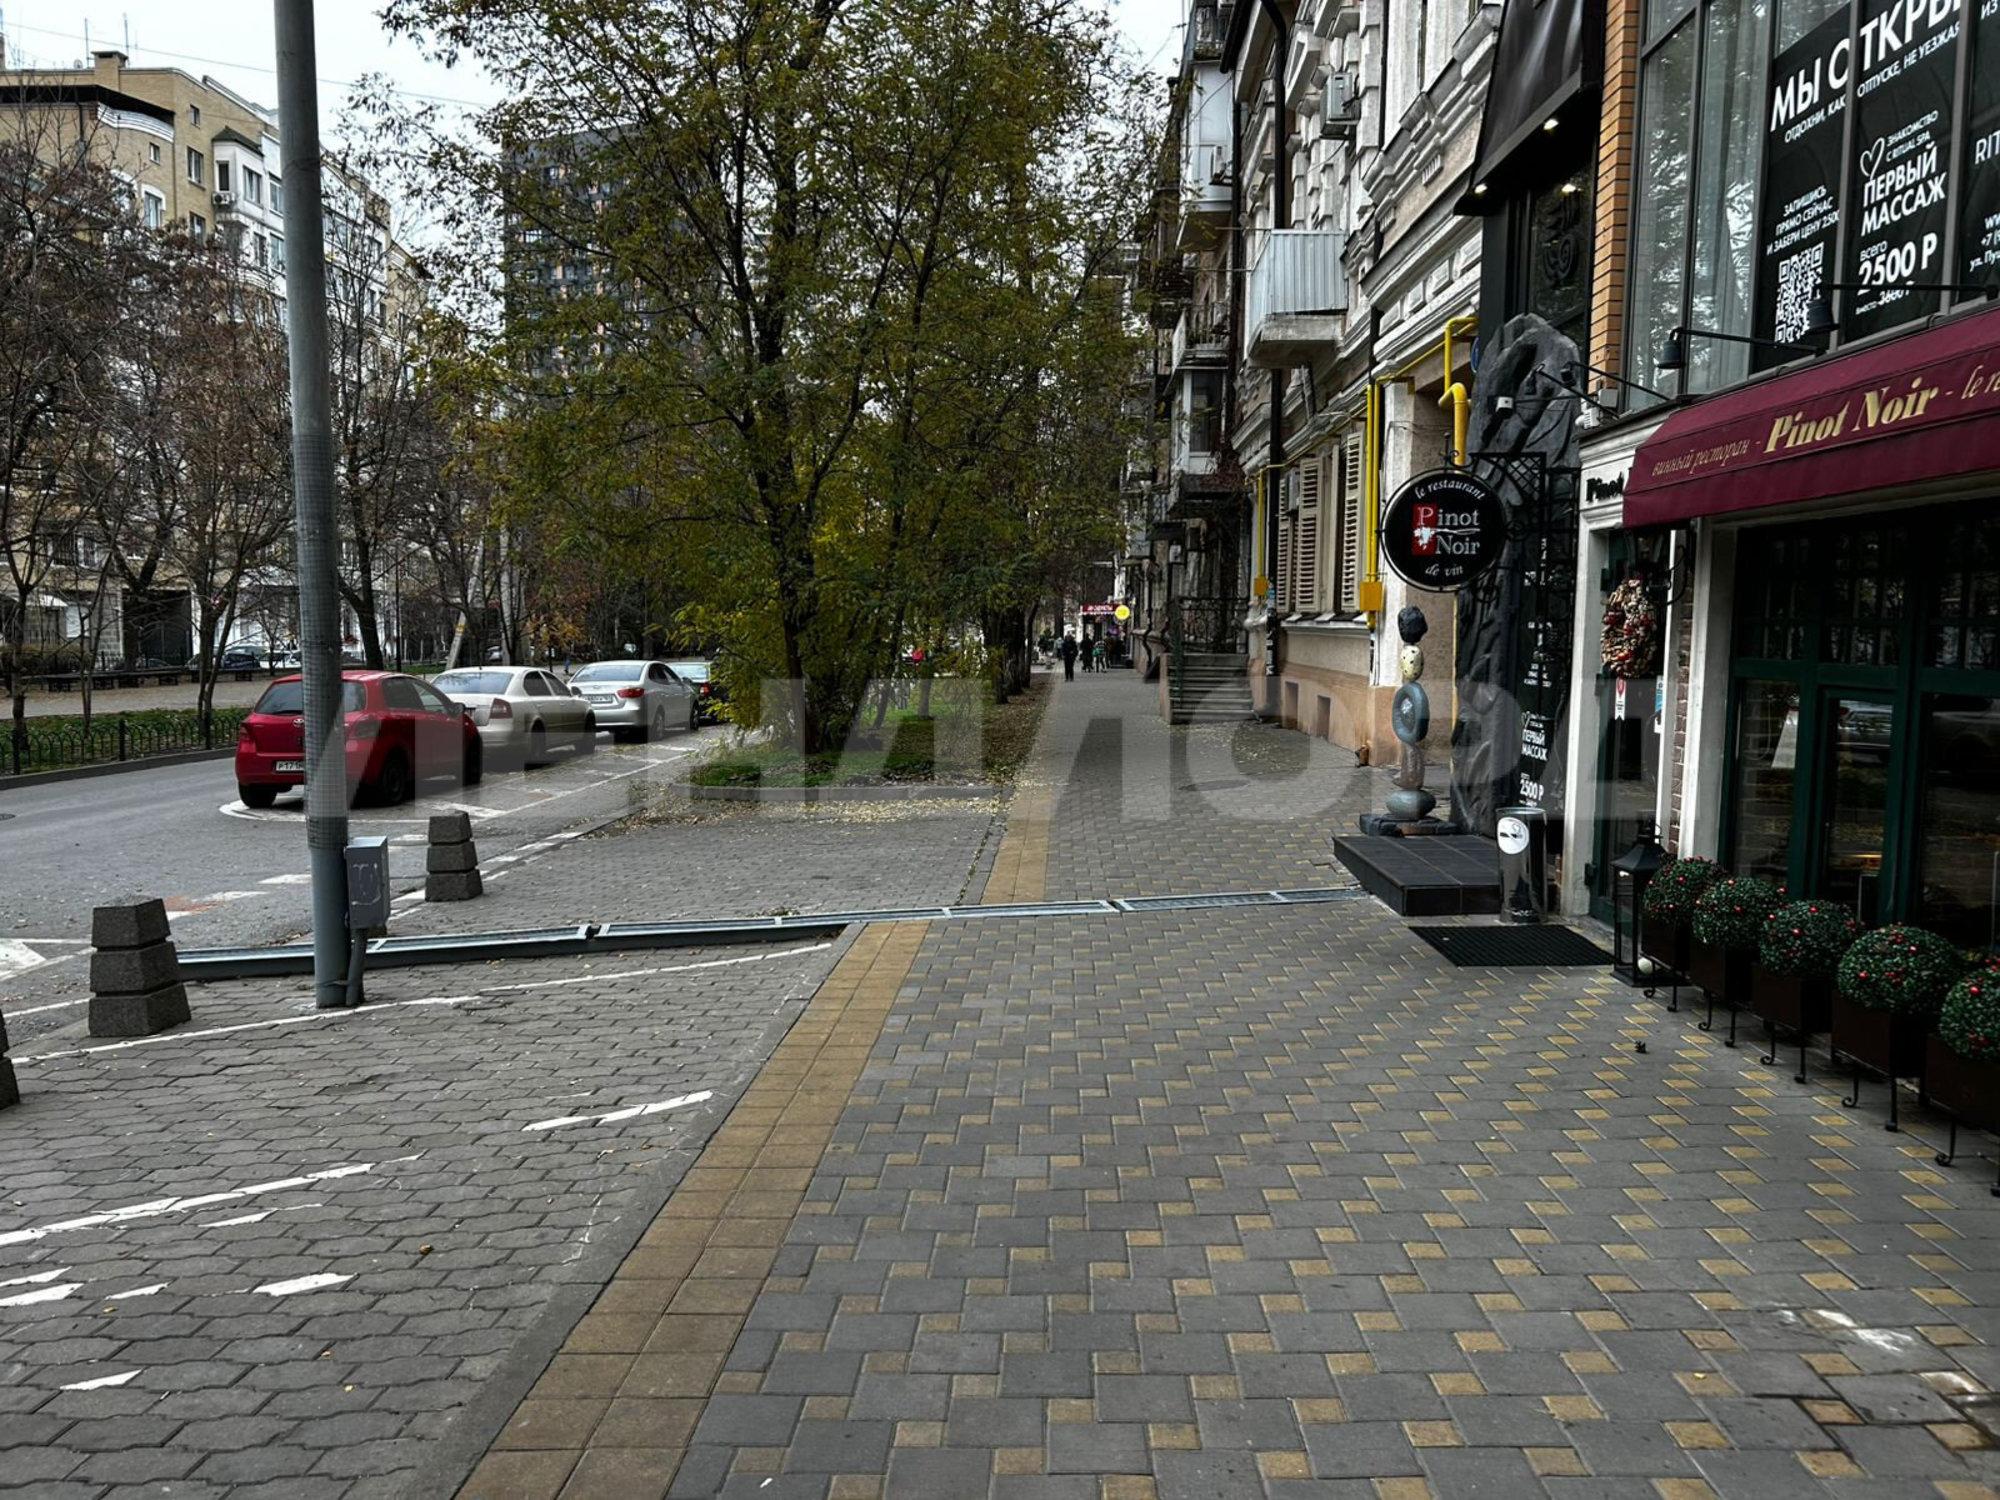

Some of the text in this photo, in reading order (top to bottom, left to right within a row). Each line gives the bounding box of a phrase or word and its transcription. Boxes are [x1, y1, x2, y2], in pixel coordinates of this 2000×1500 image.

[1770, 57, 1821, 132] МЫ
[1828, 93, 1846, 116] КАК
[1857, 60, 1901, 97] ОТПУСКЕ,
[1903, 49, 1917, 69] НЕ
[1887, 110, 1938, 147] ЗНАКОМСТВО
[1917, 130, 1931, 146] SPA
[1863, 141, 1938, 207] ПЕРВЫЙ
[1775, 196, 1833, 236] ПРЯМО СЕЙЧАС
[1783, 185, 1827, 217] ЗАПИШИСЬ
[1861, 171, 1947, 237] МАССАЖ
[1774, 230, 1800, 252] ЗАБЕРИ
[1801, 219, 1820, 239] ЦЕНУ
[1857, 241, 1916, 296] 2500
[1763, 401, 1850, 453] Pinot
[1851, 377, 1939, 432] Noir
[1961, 365, 1984, 399] le
[1652, 439, 1750, 476] винный ресторан
[1415, 479, 1486, 499] le restaurant
[1418, 507, 1480, 526] Pinot
[1435, 535, 1480, 555] Noir
[1425, 563, 1463, 576] de vin
[1521, 742, 1548, 761] МАССАЖ
[1522, 728, 1546, 746] ПЕРВЫЙ
[1520, 778, 1538, 800] 2500
